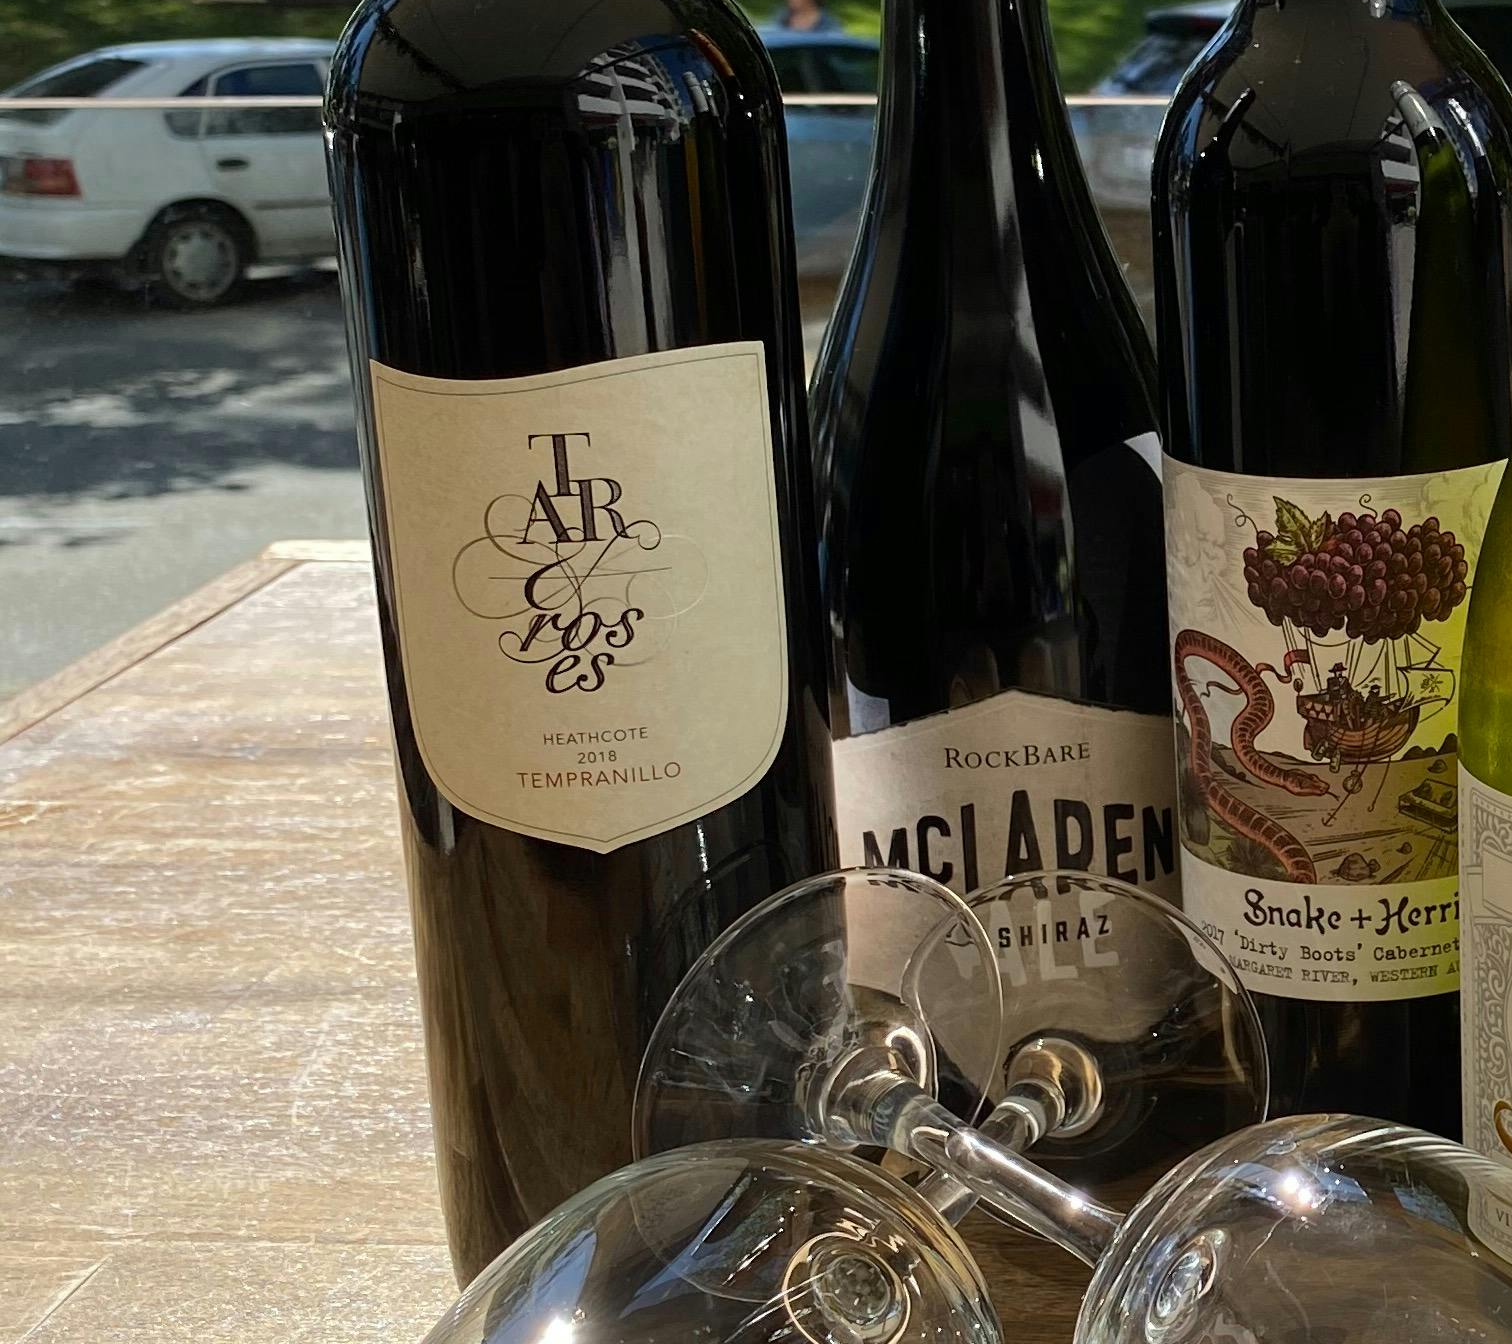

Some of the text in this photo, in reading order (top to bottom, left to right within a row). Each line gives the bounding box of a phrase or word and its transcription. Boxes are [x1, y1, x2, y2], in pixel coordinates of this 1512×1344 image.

[543, 726, 649, 746] HEATHCOTE
[577, 749, 618, 765] 2018
[516, 761, 682, 789] TEMPRANILLO
[1243, 887, 1342, 935] Snake
[998, 914, 1110, 948] SHIRAZ
[1373, 936, 1460, 962] Cabernet
[1301, 968, 1359, 987] RIVER,
[1369, 963, 1438, 984] WESTERN
